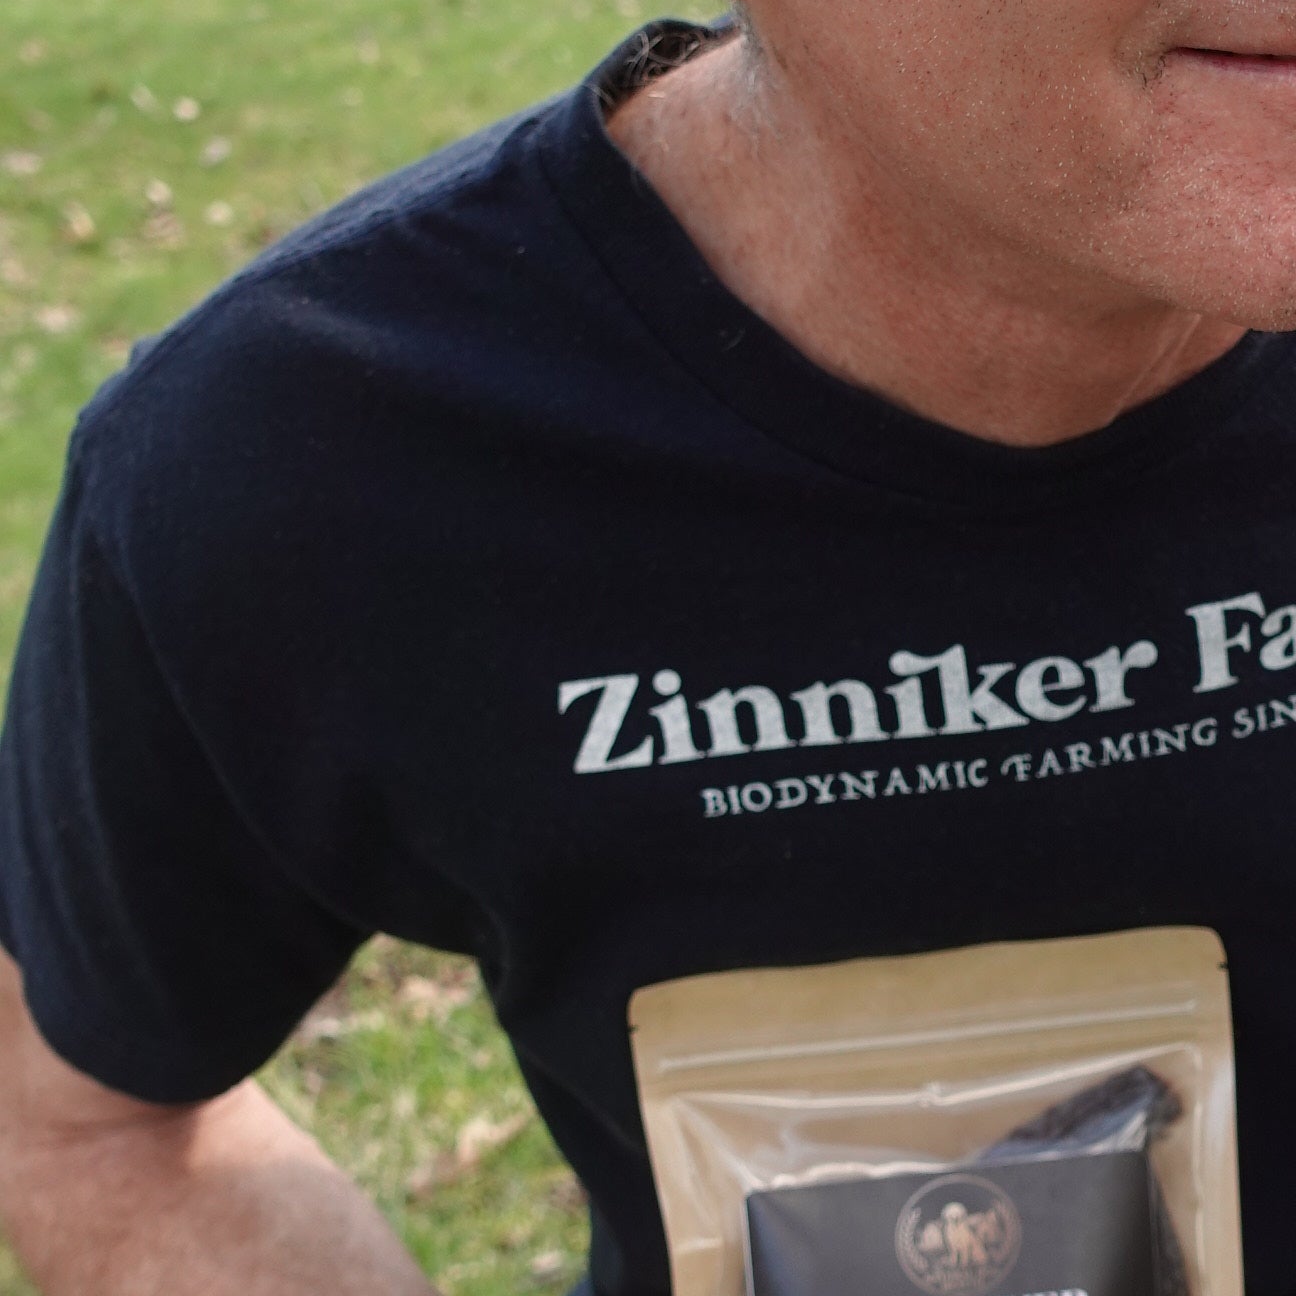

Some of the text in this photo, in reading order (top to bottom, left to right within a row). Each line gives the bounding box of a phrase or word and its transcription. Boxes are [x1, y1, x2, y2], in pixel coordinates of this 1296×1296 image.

[558, 640, 1159, 774] Zinniker
[702, 758, 988, 818] BIODYNAMIC
[1001, 717, 1219, 782] FARMING
